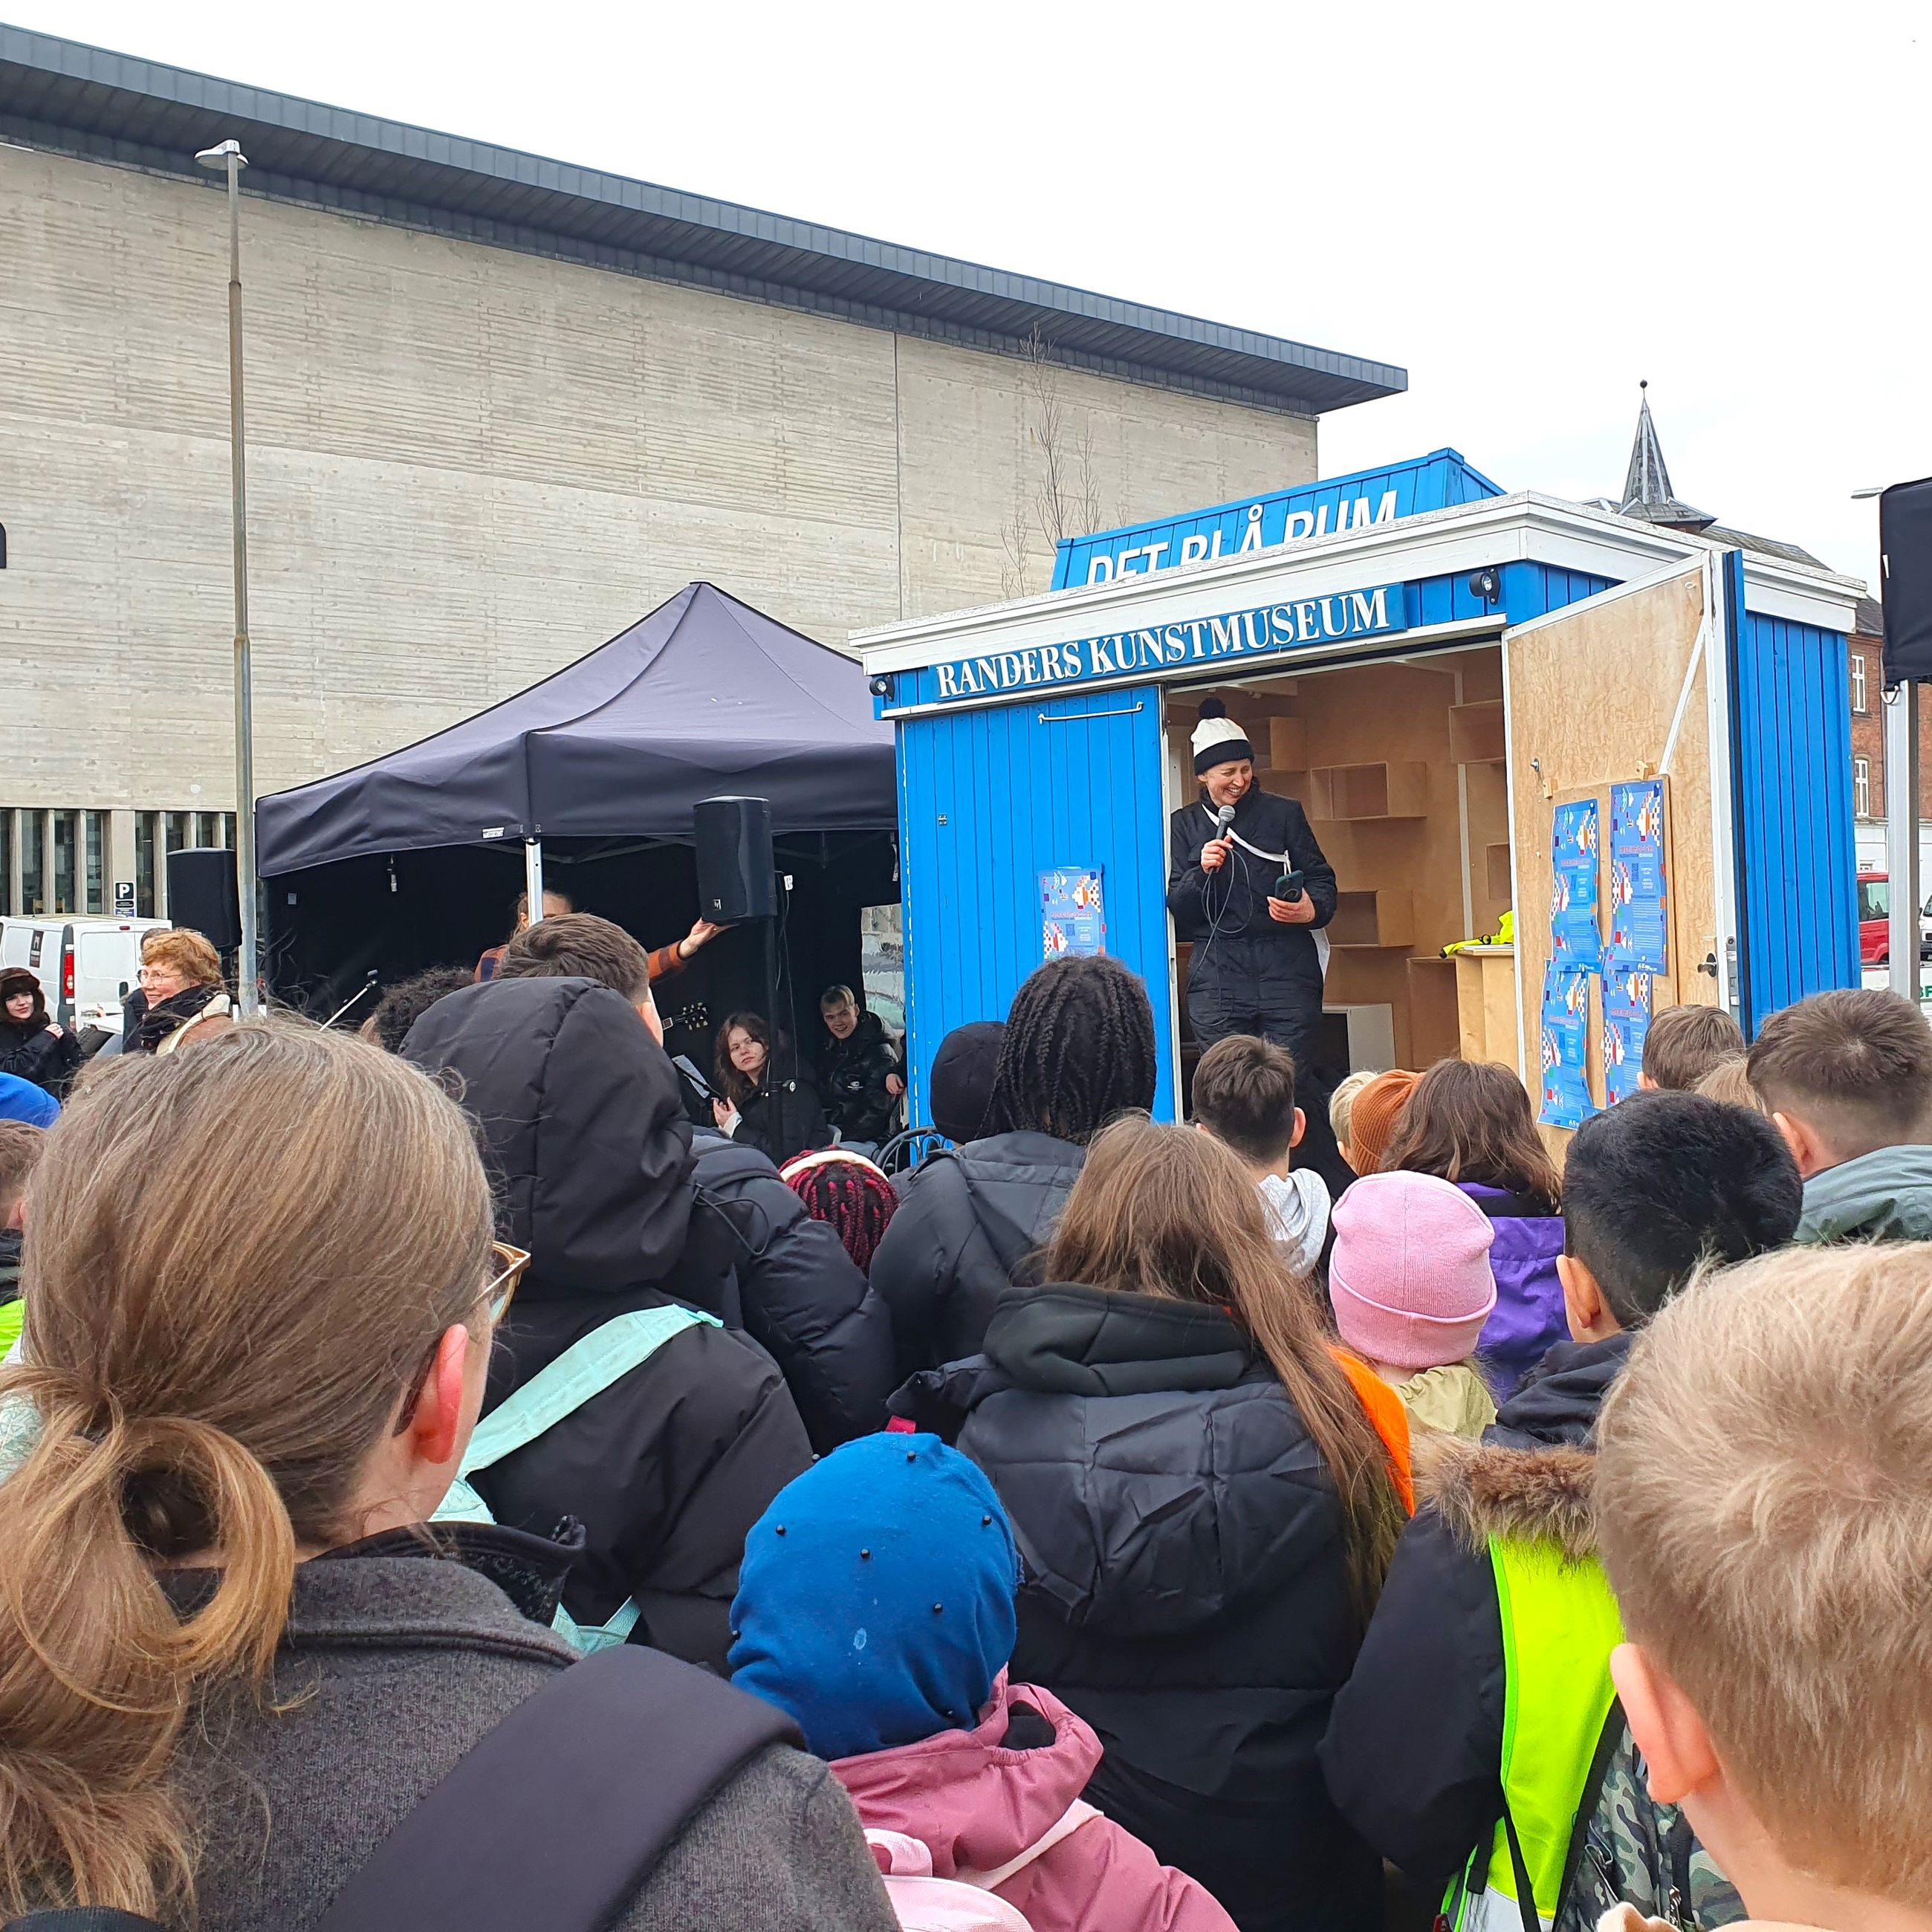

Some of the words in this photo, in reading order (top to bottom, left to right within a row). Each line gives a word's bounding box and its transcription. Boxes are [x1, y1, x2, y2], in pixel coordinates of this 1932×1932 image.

[936, 641, 1083, 698] RANDERS
[1087, 589, 1391, 675] KUNSTMUSEUM
[119, 884, 130, 898] P
